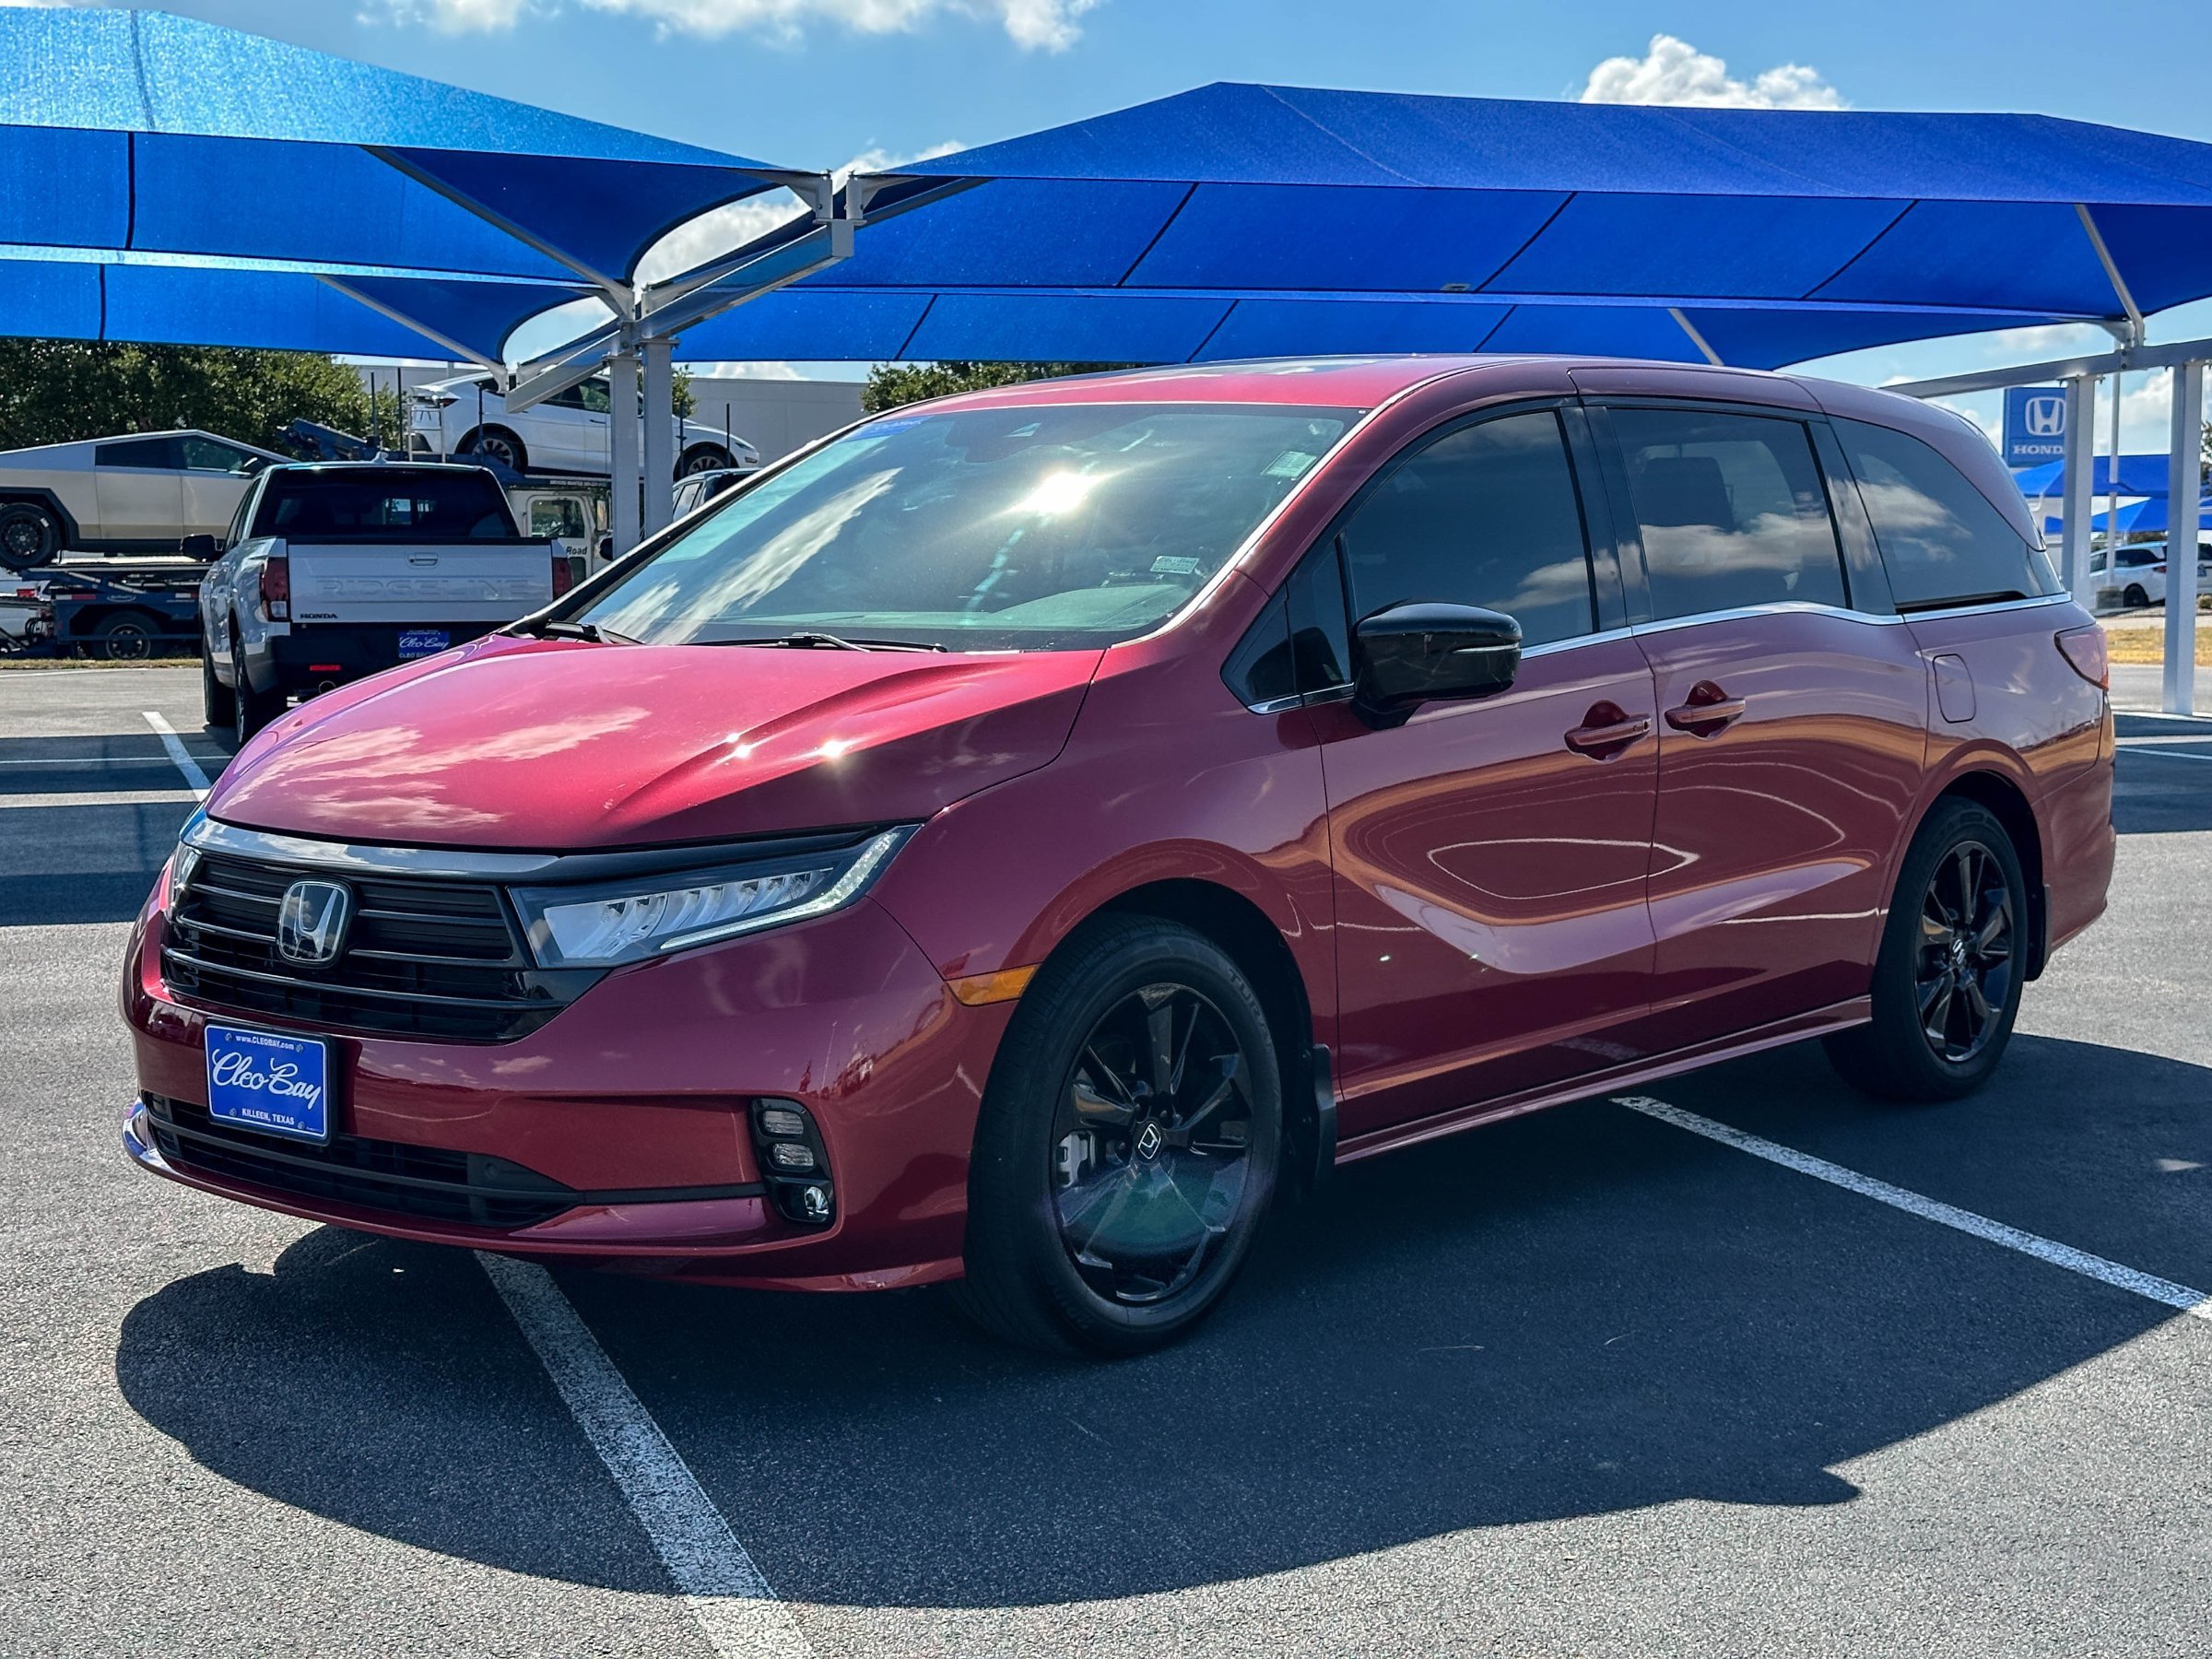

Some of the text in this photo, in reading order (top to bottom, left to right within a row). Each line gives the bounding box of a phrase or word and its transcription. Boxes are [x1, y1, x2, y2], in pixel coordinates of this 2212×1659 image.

[2013, 444, 2065, 454] HOND
[316, 579, 529, 596] RIDGELINE
[235, 1035, 295, 1051] www.CLEOBAY.com
[212, 1049, 322, 1110] Cleo Bay
[241, 1108, 295, 1125] KILLEEN, TEXAS
